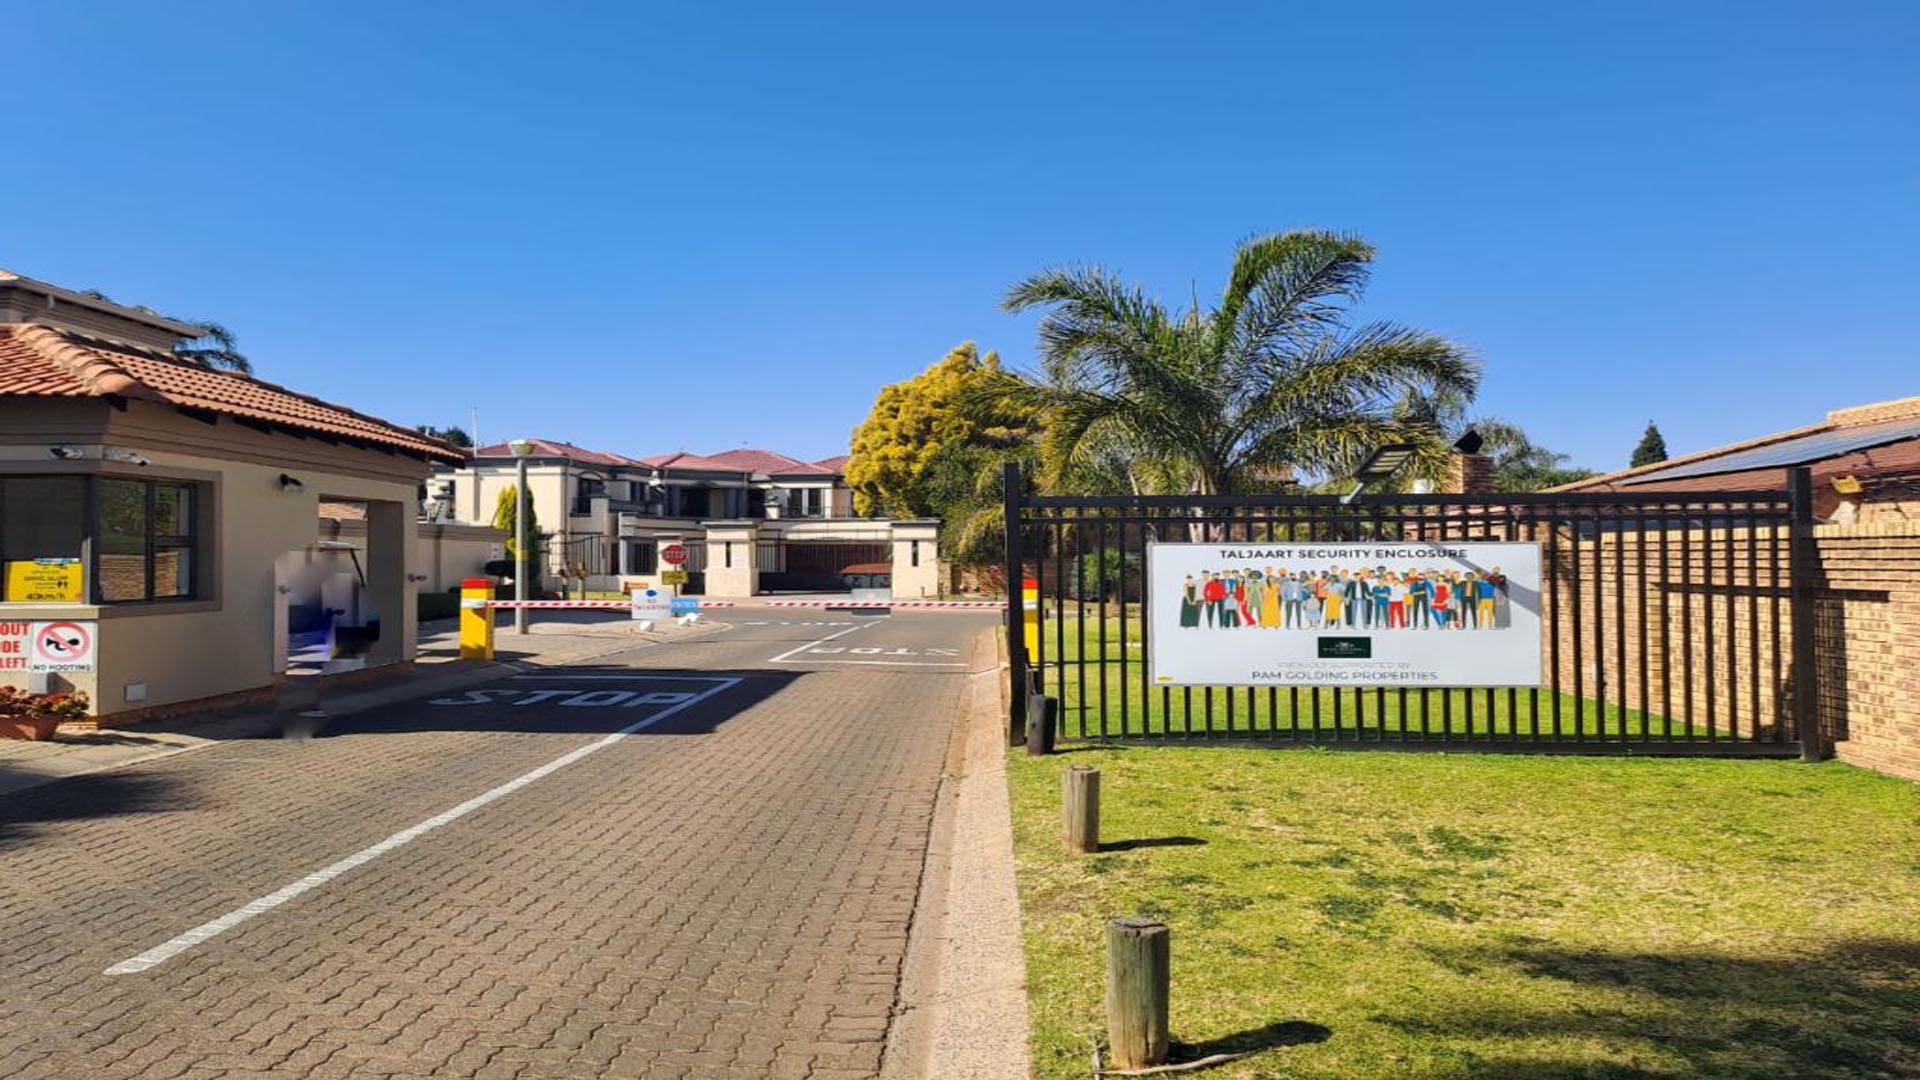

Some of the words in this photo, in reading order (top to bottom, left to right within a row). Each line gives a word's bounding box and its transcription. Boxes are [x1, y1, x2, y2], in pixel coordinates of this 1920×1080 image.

[664, 551, 685, 559] STOP
[1220, 550, 1293, 559] TALJAART
[1298, 549, 1371, 559] SECURITY
[1375, 549, 1468, 559] ENCLOSURE
[1252, 671, 1281, 679] PAM
[1286, 671, 1348, 680] GOLDING
[1352, 671, 1438, 680] PROPERTIES
[429, 689, 698, 706] STOP
